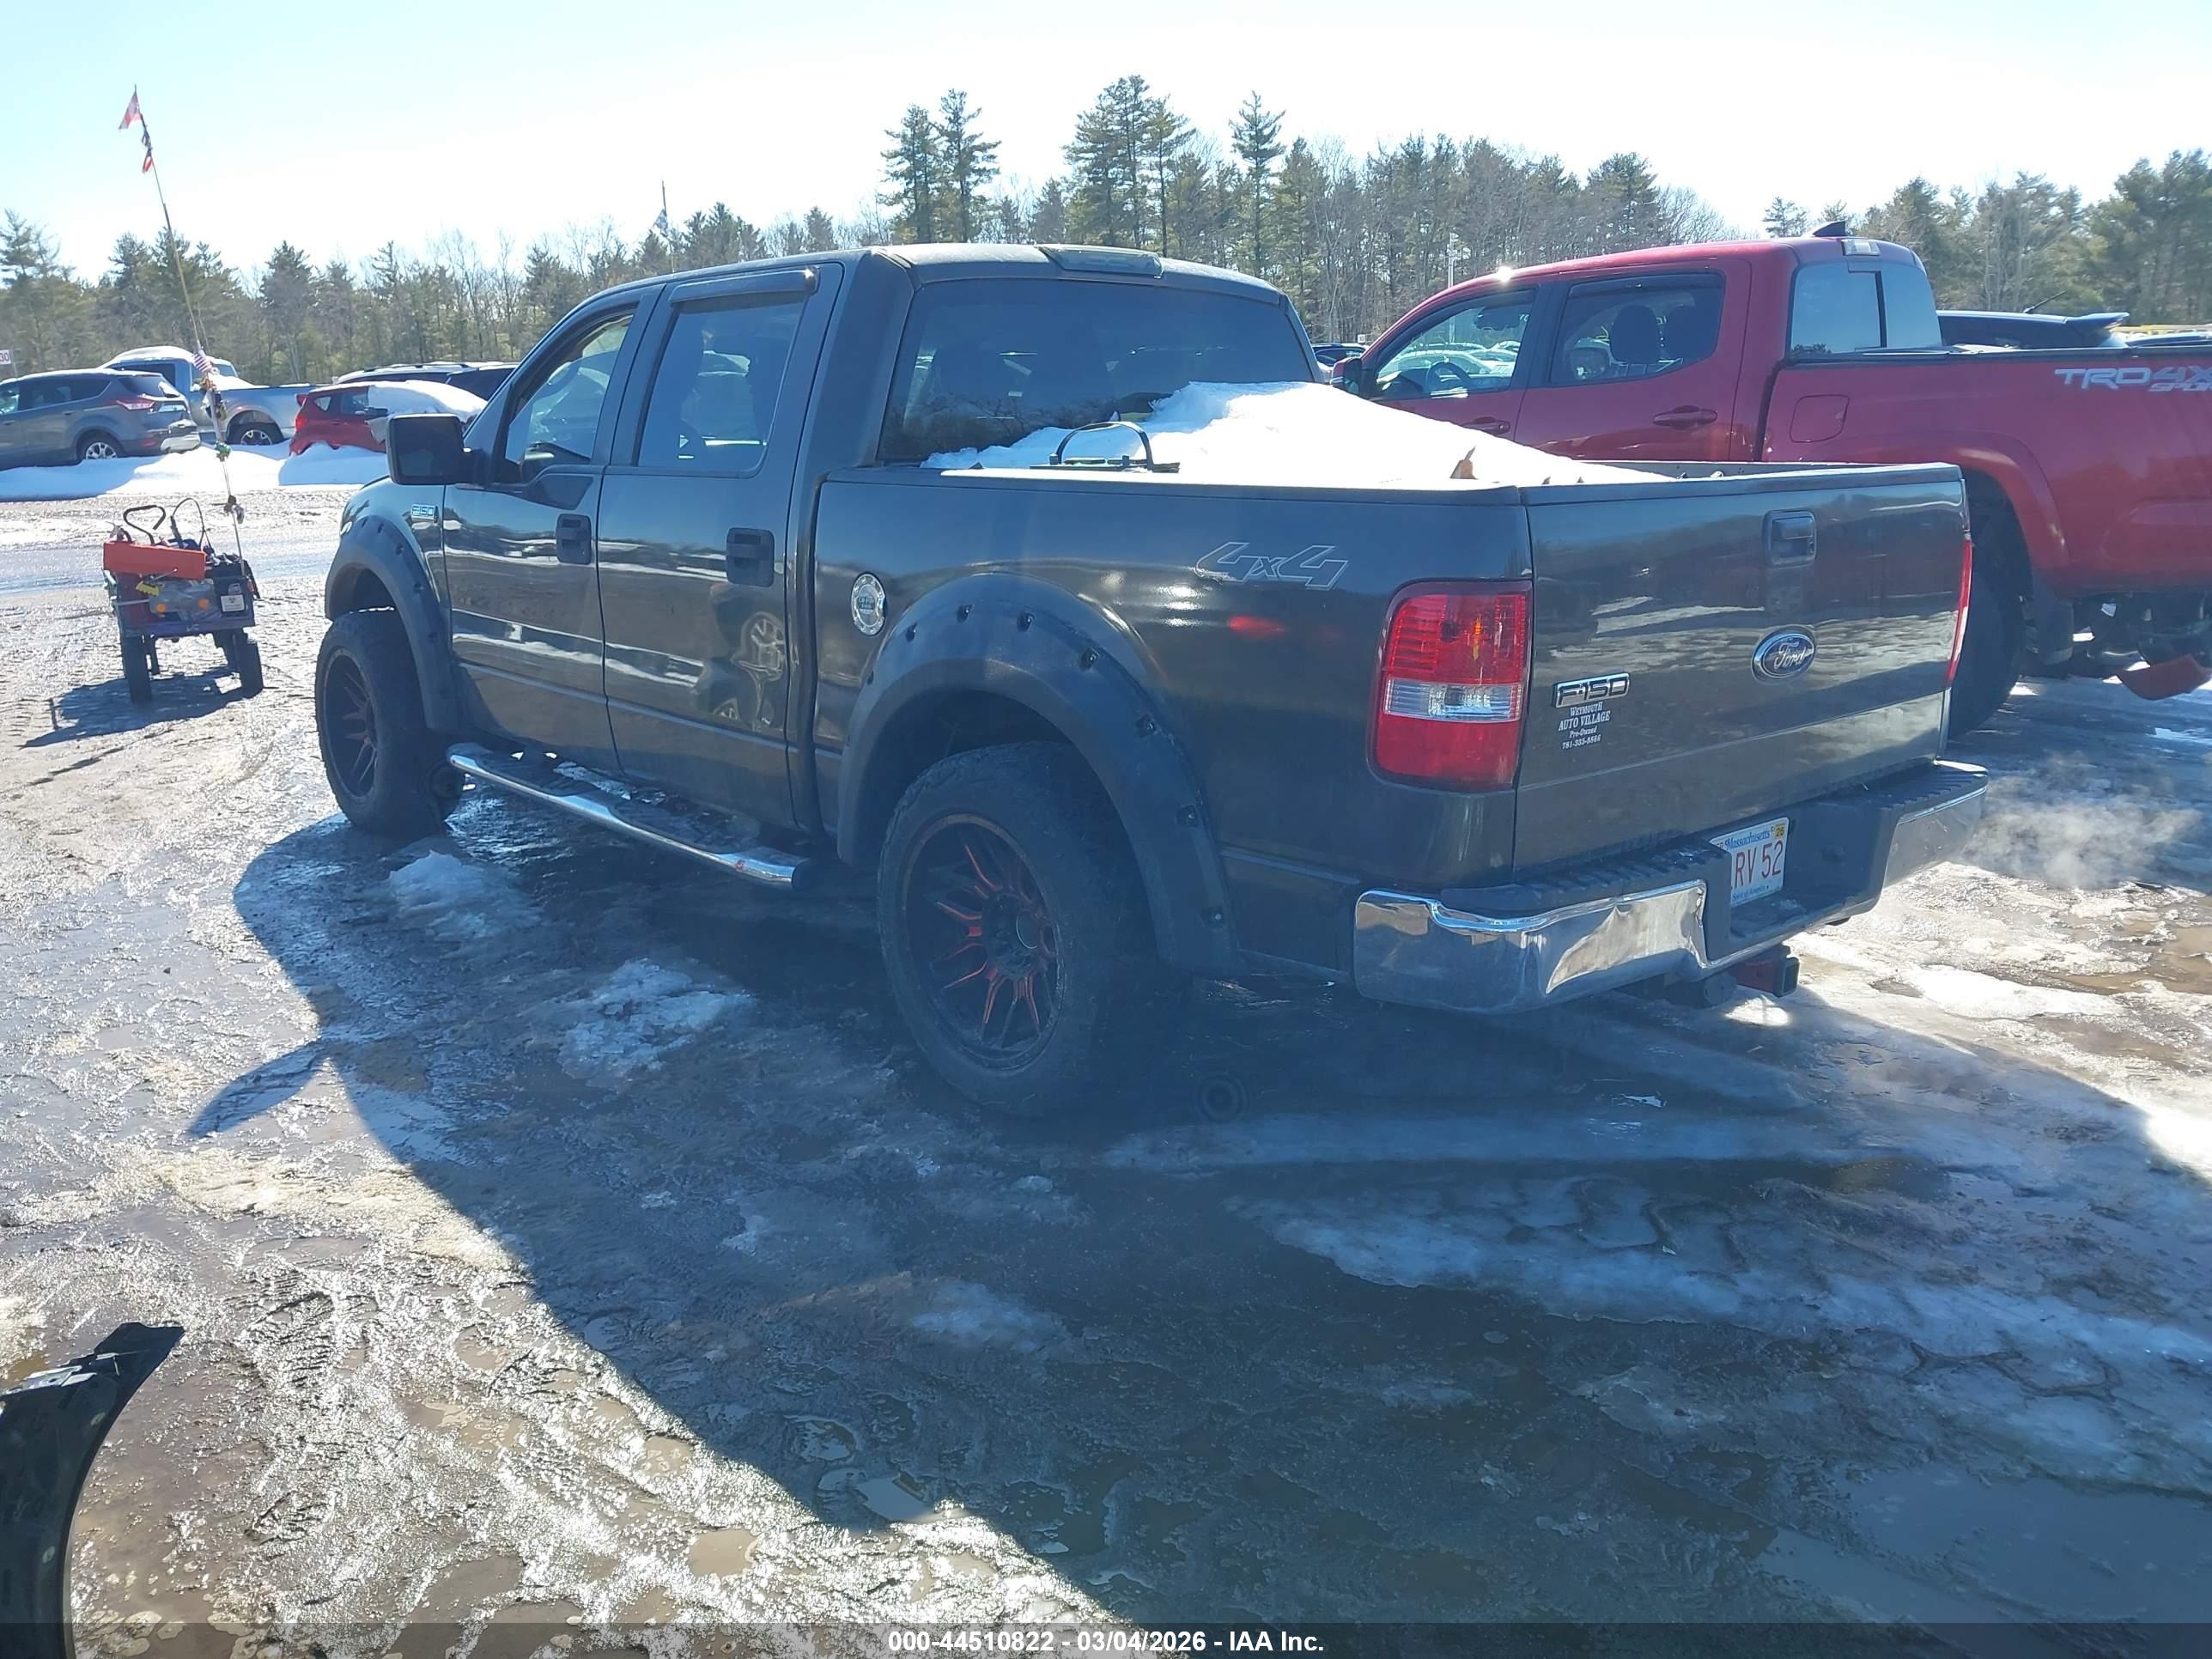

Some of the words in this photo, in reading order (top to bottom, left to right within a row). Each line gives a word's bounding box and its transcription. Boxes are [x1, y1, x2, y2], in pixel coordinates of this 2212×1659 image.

[2054, 367, 2153, 389] TRD
[1194, 542, 1349, 591] 4x4
[1773, 641, 1807, 670] Ford
[1570, 701, 1603, 717] WEYMOUTH
[1558, 717, 1579, 732] AUTO
[1580, 710, 1611, 726] VILLAGE
[1569, 725, 1598, 738] Pre-Owned
[1731, 847, 1757, 890] RV
[1761, 840, 1784, 879] 52
